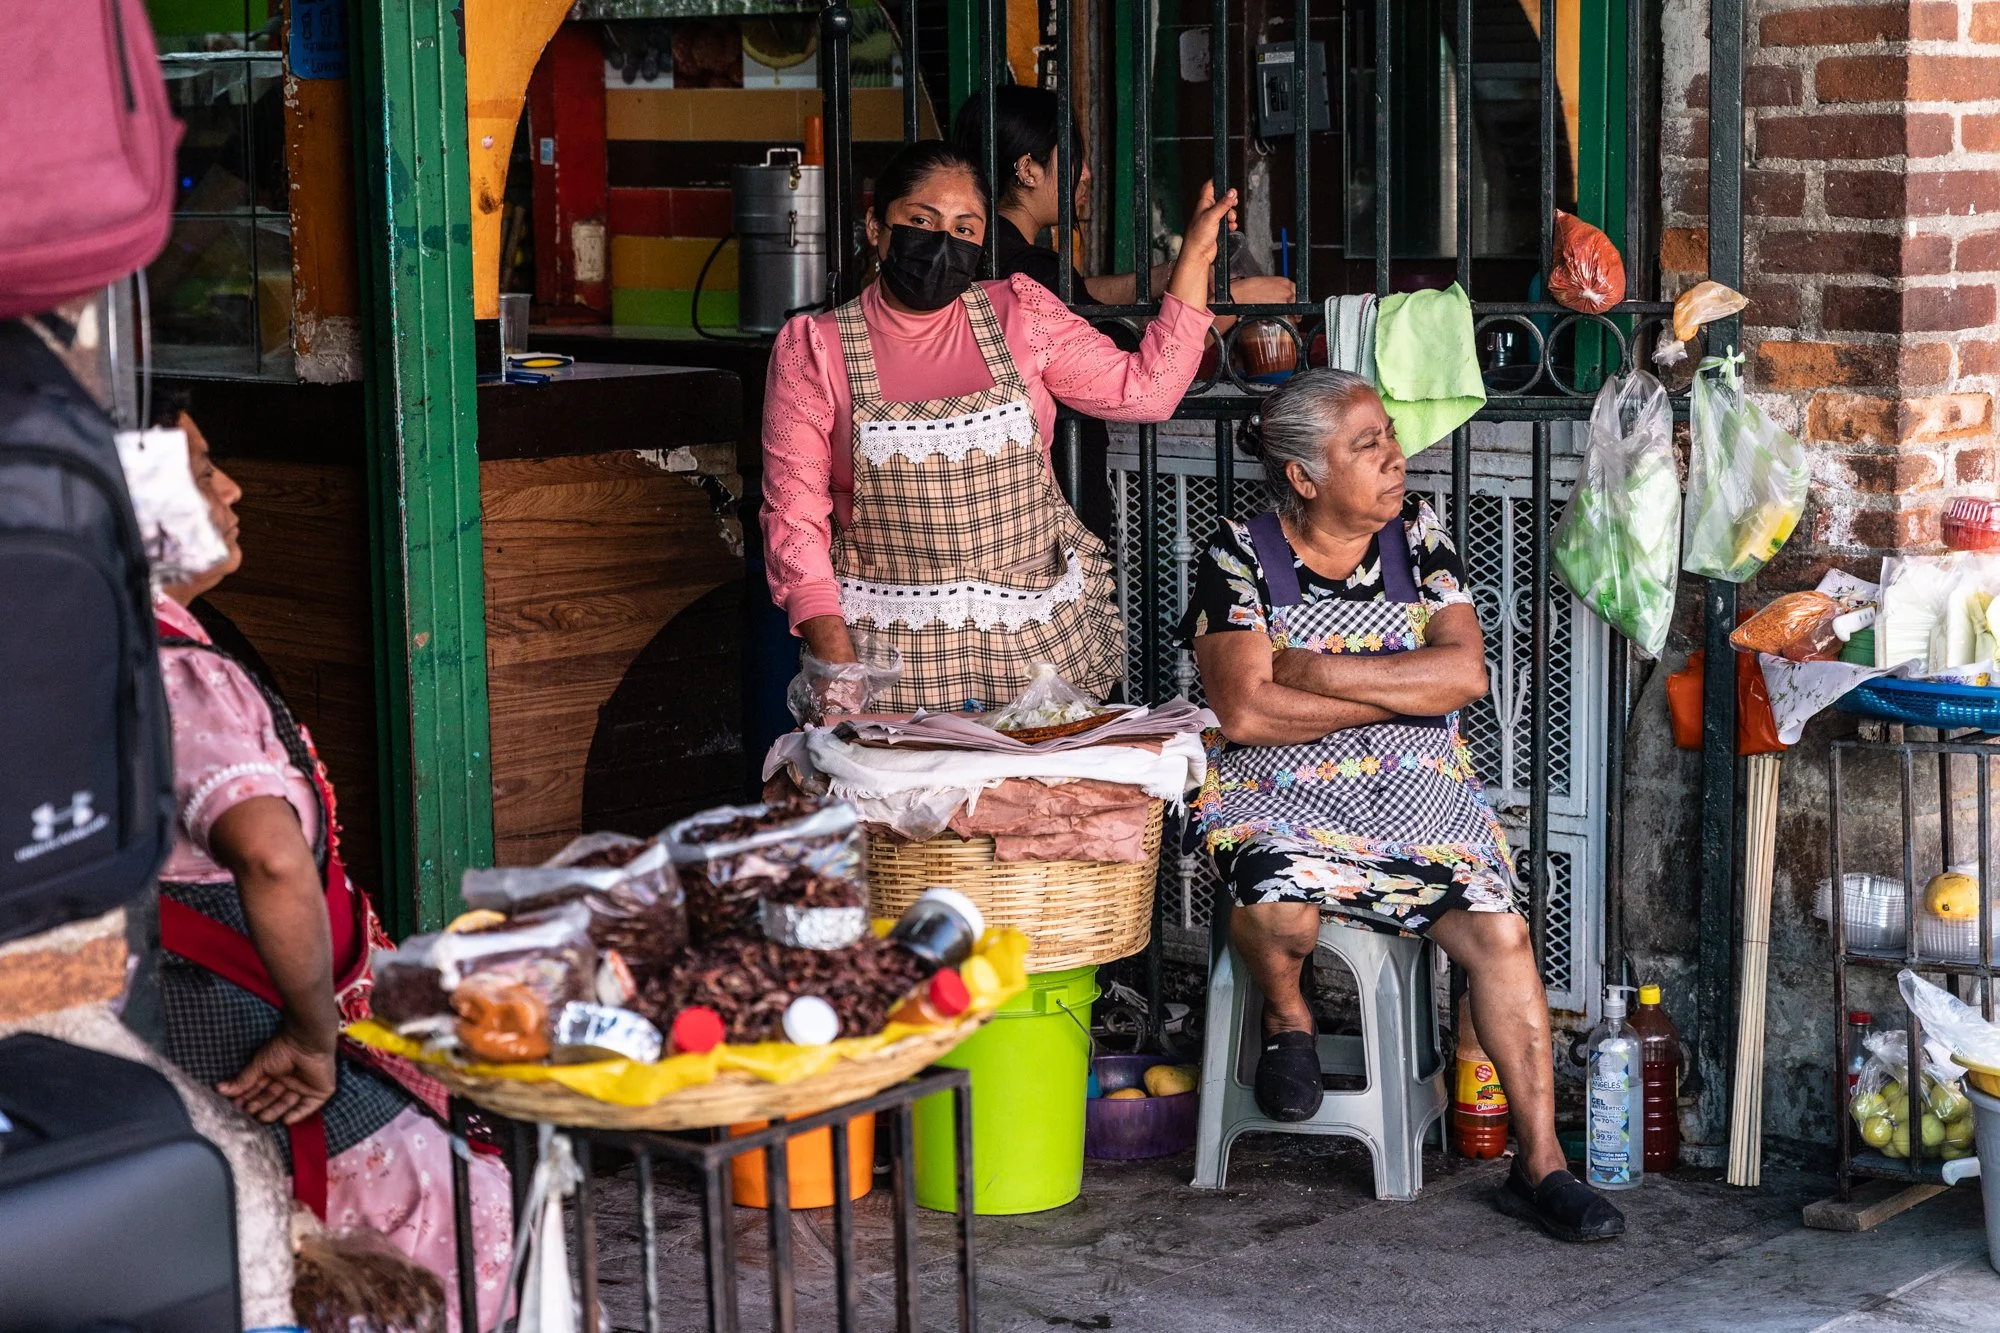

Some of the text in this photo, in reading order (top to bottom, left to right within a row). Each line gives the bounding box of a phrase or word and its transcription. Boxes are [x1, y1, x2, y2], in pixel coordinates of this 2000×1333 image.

[1592, 1080, 1620, 1089] ANGELES
[1592, 1097, 1605, 1106] GEL
[1596, 1133, 1619, 1141] 99.9%
